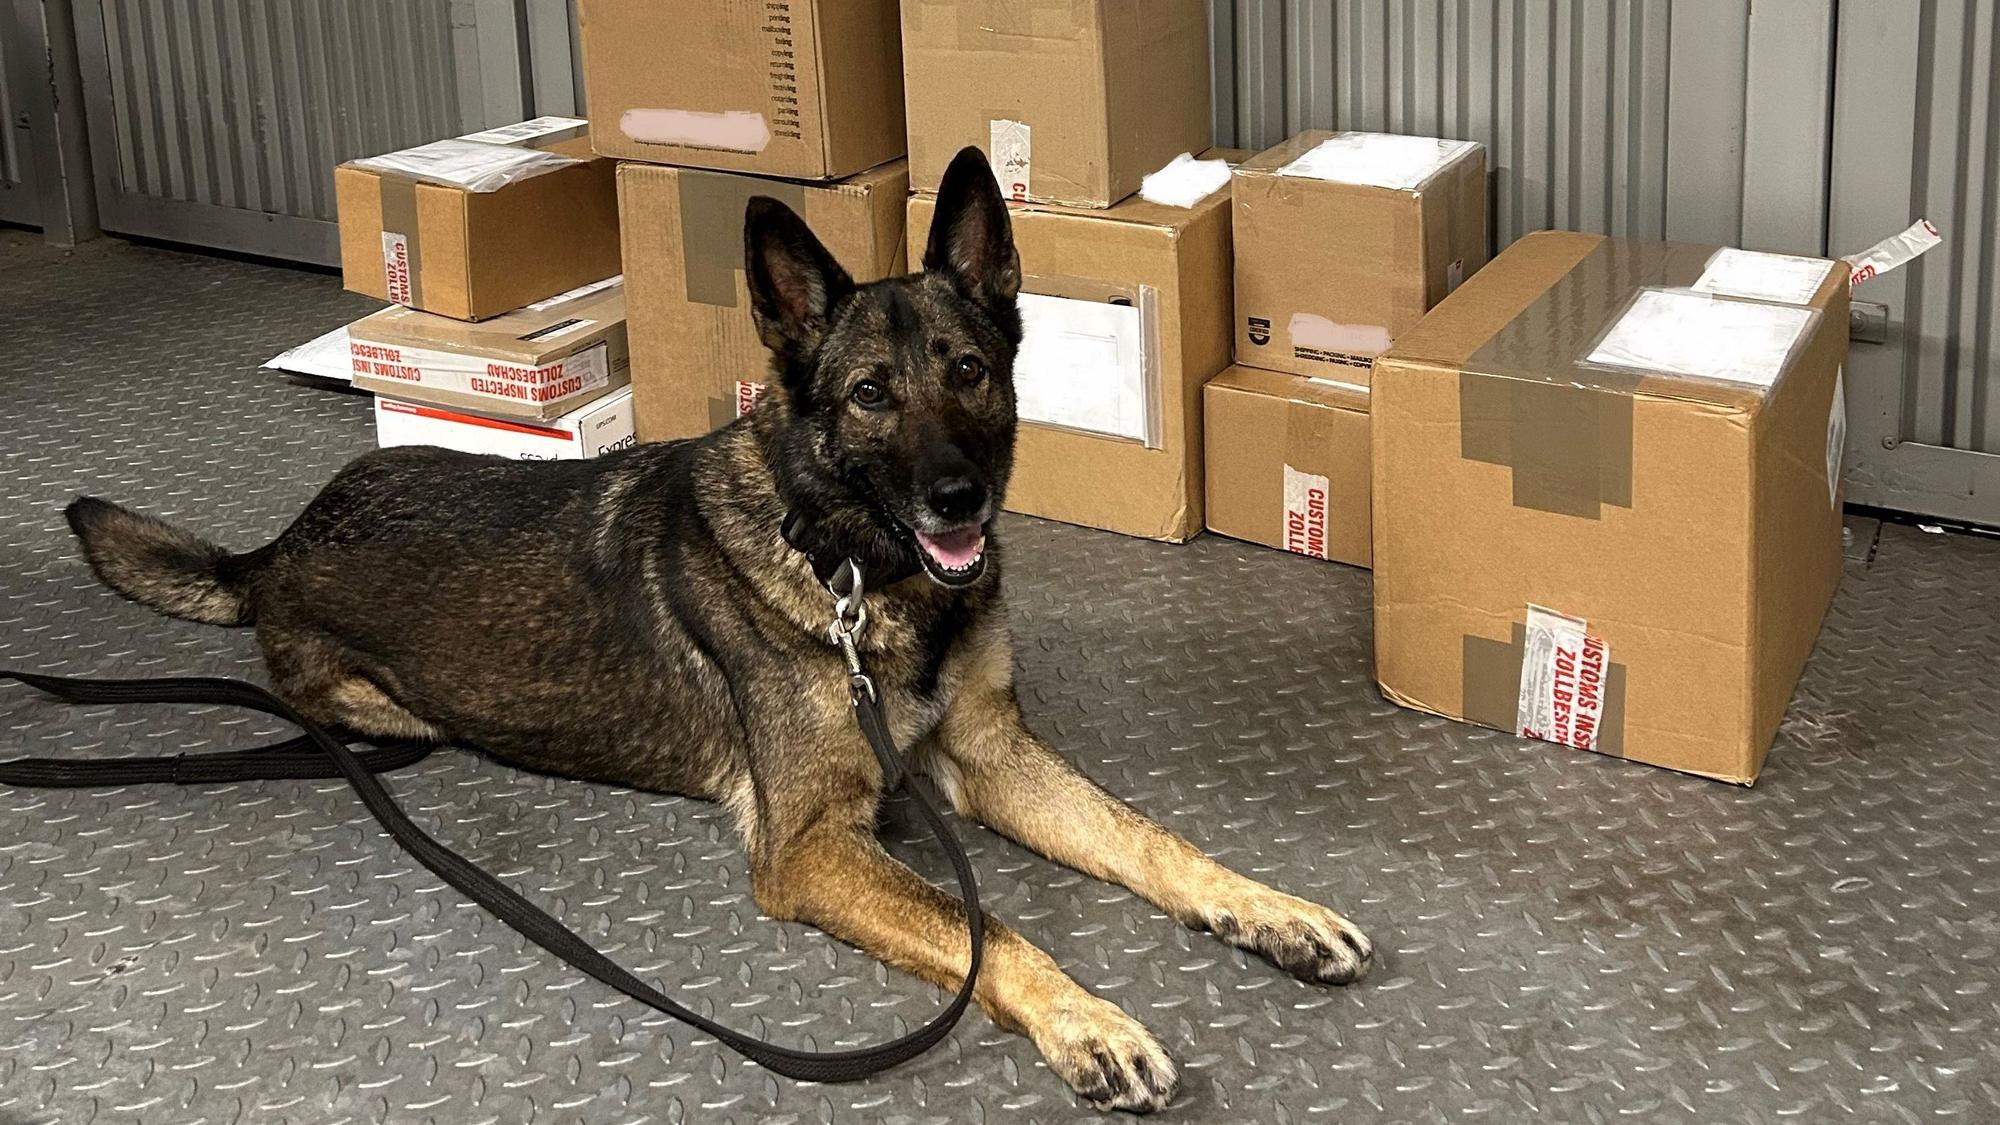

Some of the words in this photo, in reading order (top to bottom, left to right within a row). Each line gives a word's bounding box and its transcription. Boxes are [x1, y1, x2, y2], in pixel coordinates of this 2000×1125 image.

[395, 243, 410, 303] CUSTOMS
[374, 362, 421, 381] CUSTOMS
[487, 363, 563, 384] ZOLLBESCHAU
[471, 377, 528, 399] INSPECTED
[531, 375, 582, 402] CUSTOMS
[596, 414, 617, 430] UPS.COM
[1308, 488, 1325, 559] CUSTOMS
[1577, 635, 1604, 711] USTOMS
